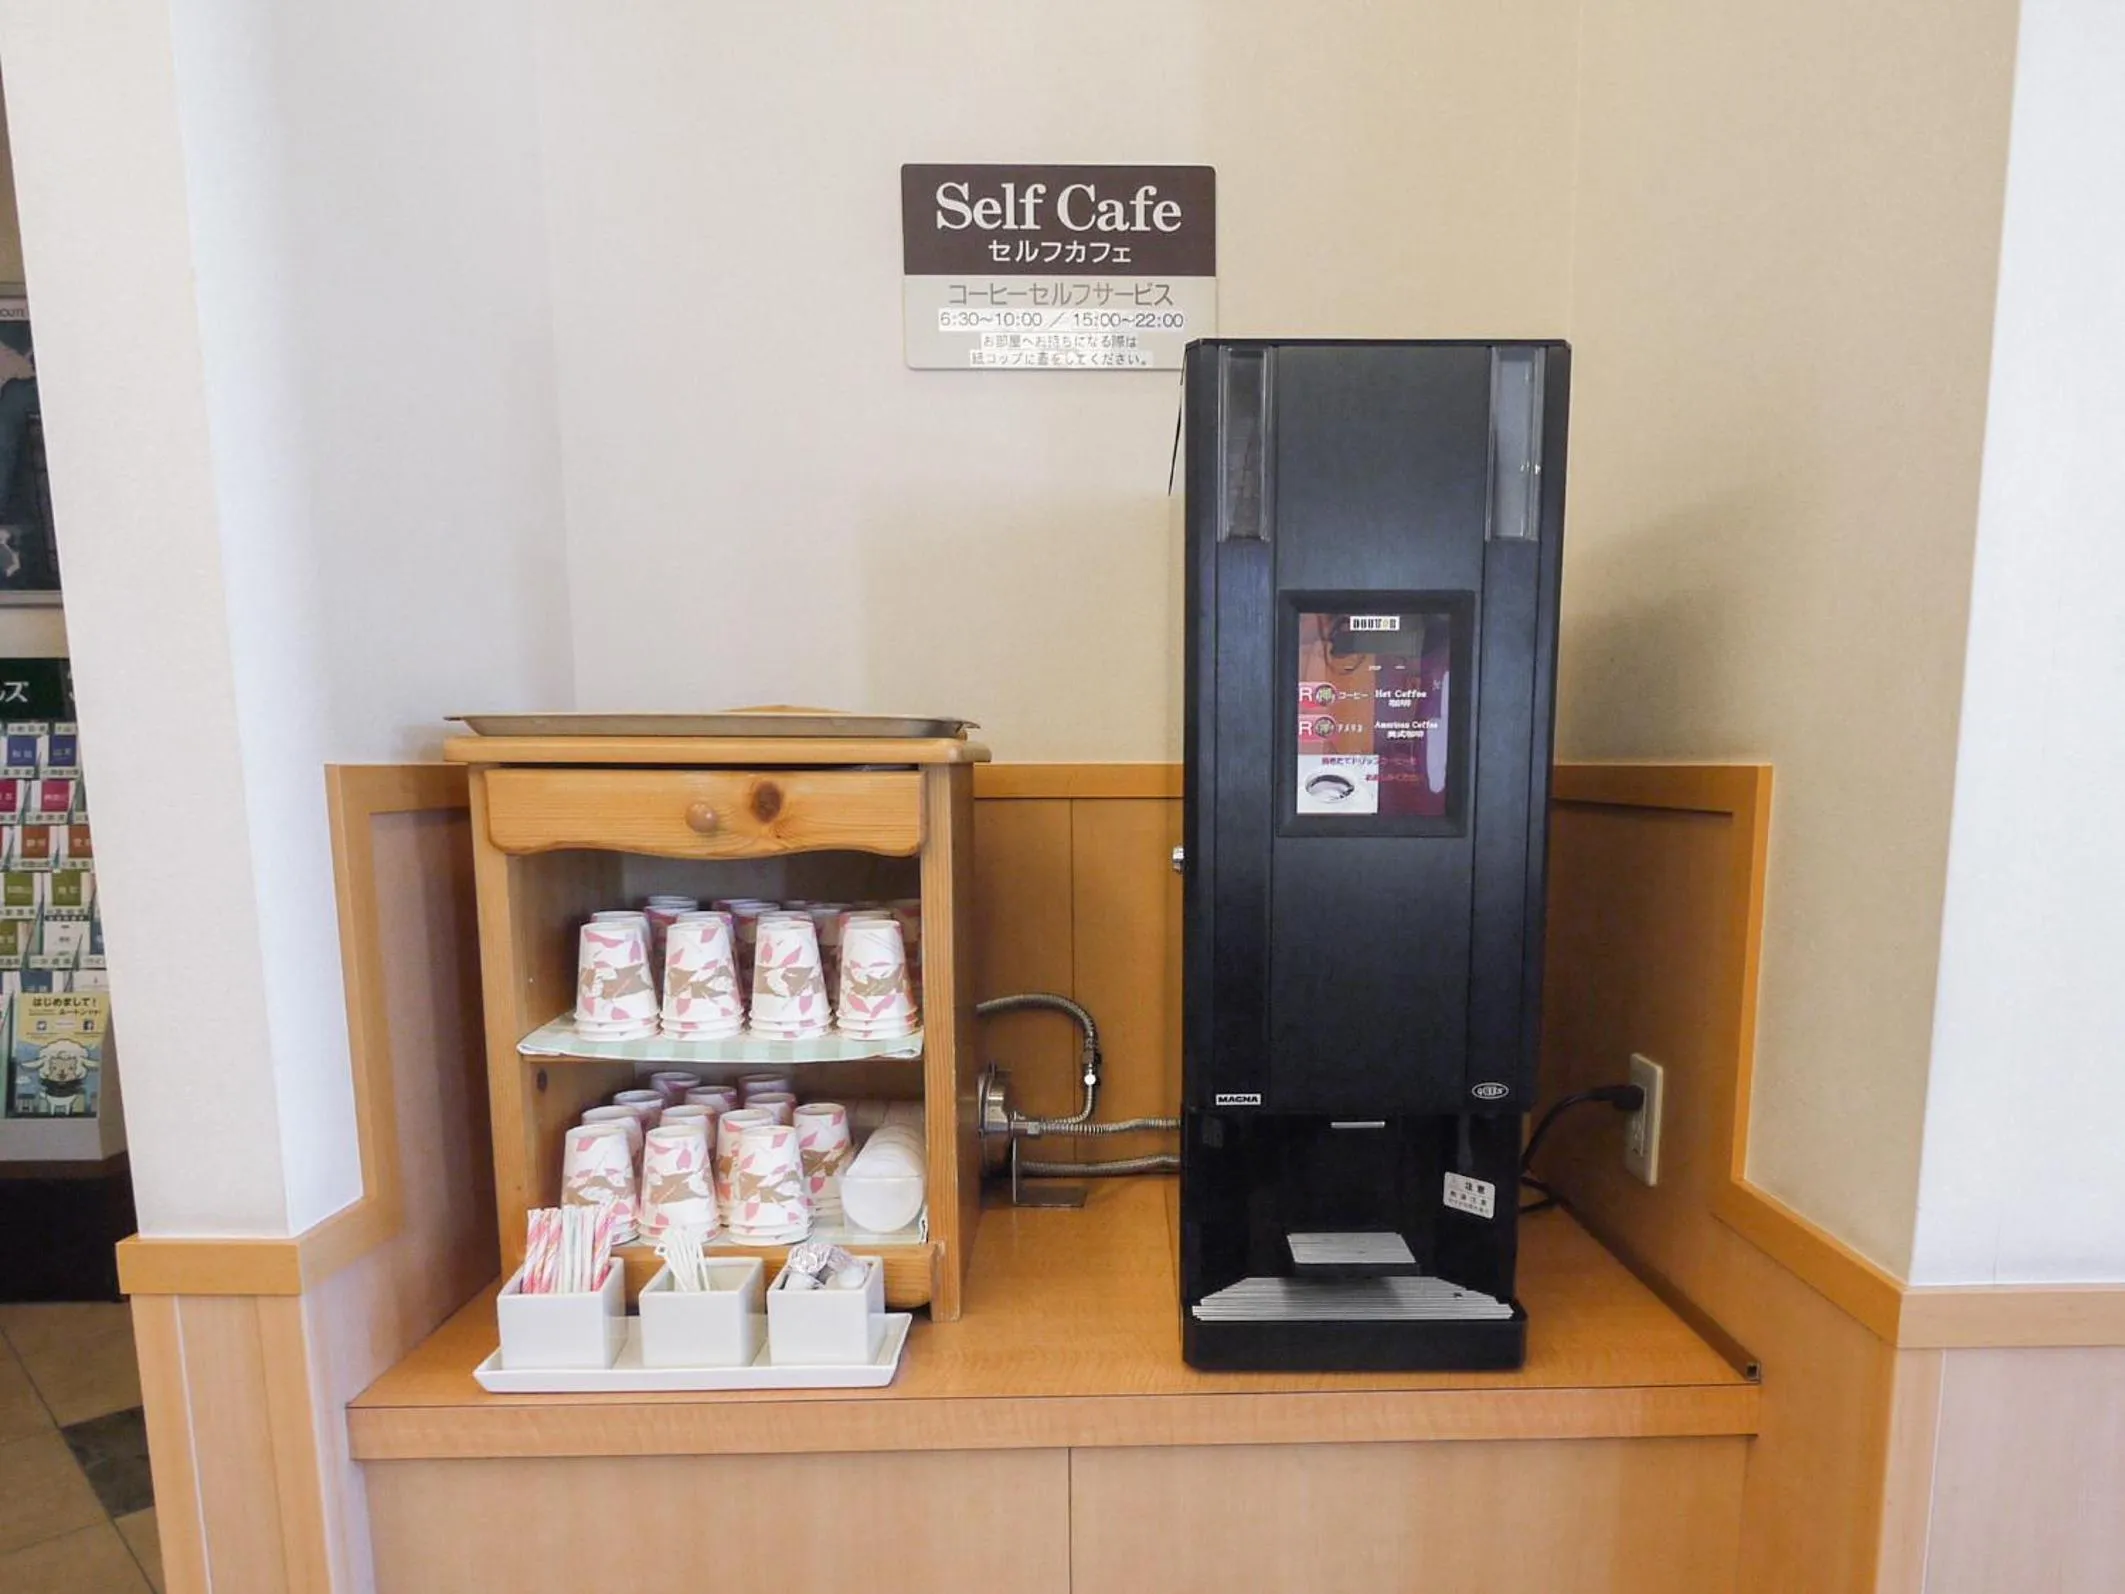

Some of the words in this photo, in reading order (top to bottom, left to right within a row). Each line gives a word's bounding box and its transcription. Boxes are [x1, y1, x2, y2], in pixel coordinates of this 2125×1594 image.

[936, 182, 1047, 230] Self
[1057, 184, 1182, 232] Cafe
[988, 239, 1132, 263] セルフカフェ
[949, 283, 1174, 306] コーヒーセルフサービス
[1394, 689, 1427, 699] Coffee
[1217, 1095, 1259, 1103] MAGNA
